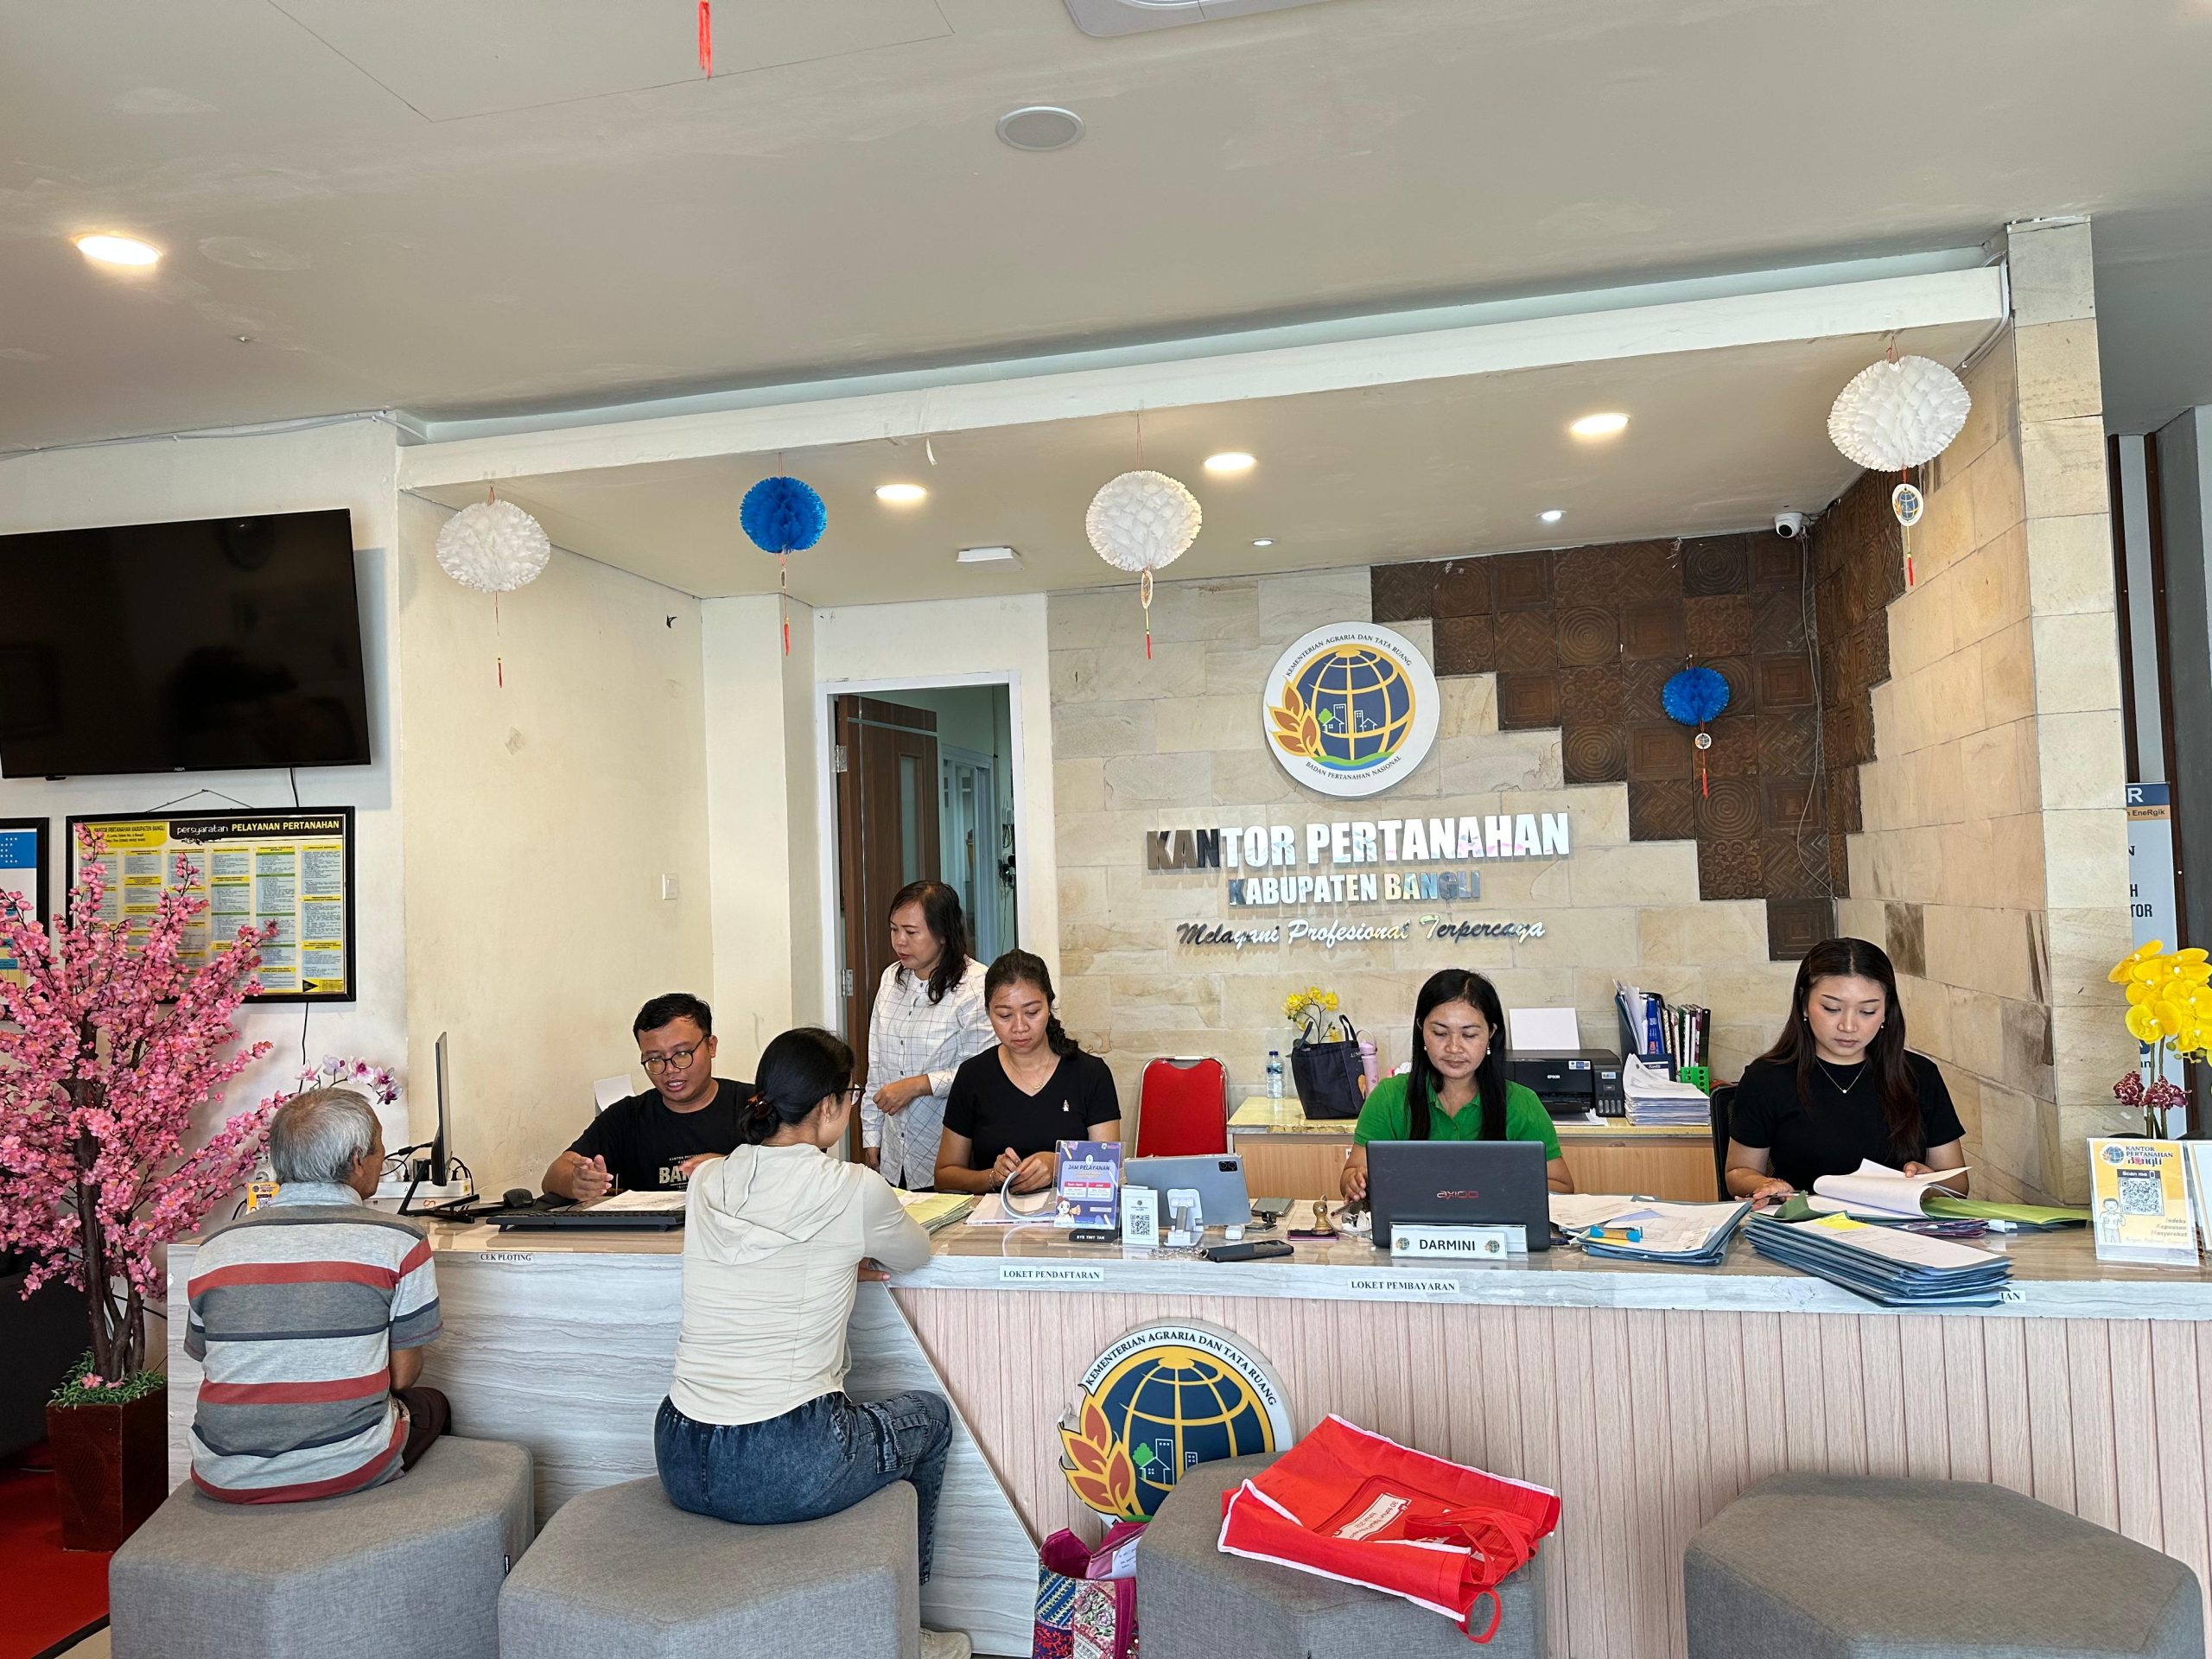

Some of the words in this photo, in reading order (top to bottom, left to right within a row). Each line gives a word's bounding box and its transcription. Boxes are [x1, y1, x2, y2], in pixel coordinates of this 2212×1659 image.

[1286, 640, 1324, 677] KEMENTERIAN
[1325, 633, 1355, 645] AGRARIA
[1376, 637, 1391, 649] TATA
[1392, 646, 1413, 666] RUANG
[1306, 760, 1326, 776] BADAN
[1327, 772, 1370, 780] PERTANAHAN
[1371, 755, 1402, 776] NASIONAL
[177, 824, 228, 835] persyaratan
[232, 823, 280, 831] PELAYANAN
[283, 821, 340, 830] PERTANAHAN
[1146, 825, 1296, 870] KANTOR
[1306, 812, 1570, 864] PERTANAHAN
[1229, 873, 1378, 906] KABUPATEN
[1383, 870, 1480, 900] BANGLI
[1176, 922, 1280, 950] Melayani
[1287, 918, 1412, 949] Profesional
[1419, 913, 1546, 944] Terpercaya
[1419, 1239, 1476, 1251] DARMINI
[1035, 1270, 1100, 1279] PENDAFTARAN
[1351, 1281, 1384, 1289] LOKET
[1387, 1281, 1455, 1291] PEMBAYARAN
[1085, 1335, 1146, 1386] KEMENTERIAN
[1147, 1331, 1196, 1342] AGRARIA
[1198, 1336, 1223, 1351] DAN
[1224, 1347, 1252, 1371] TATA
[1248, 1368, 1277, 1406] RUANG
